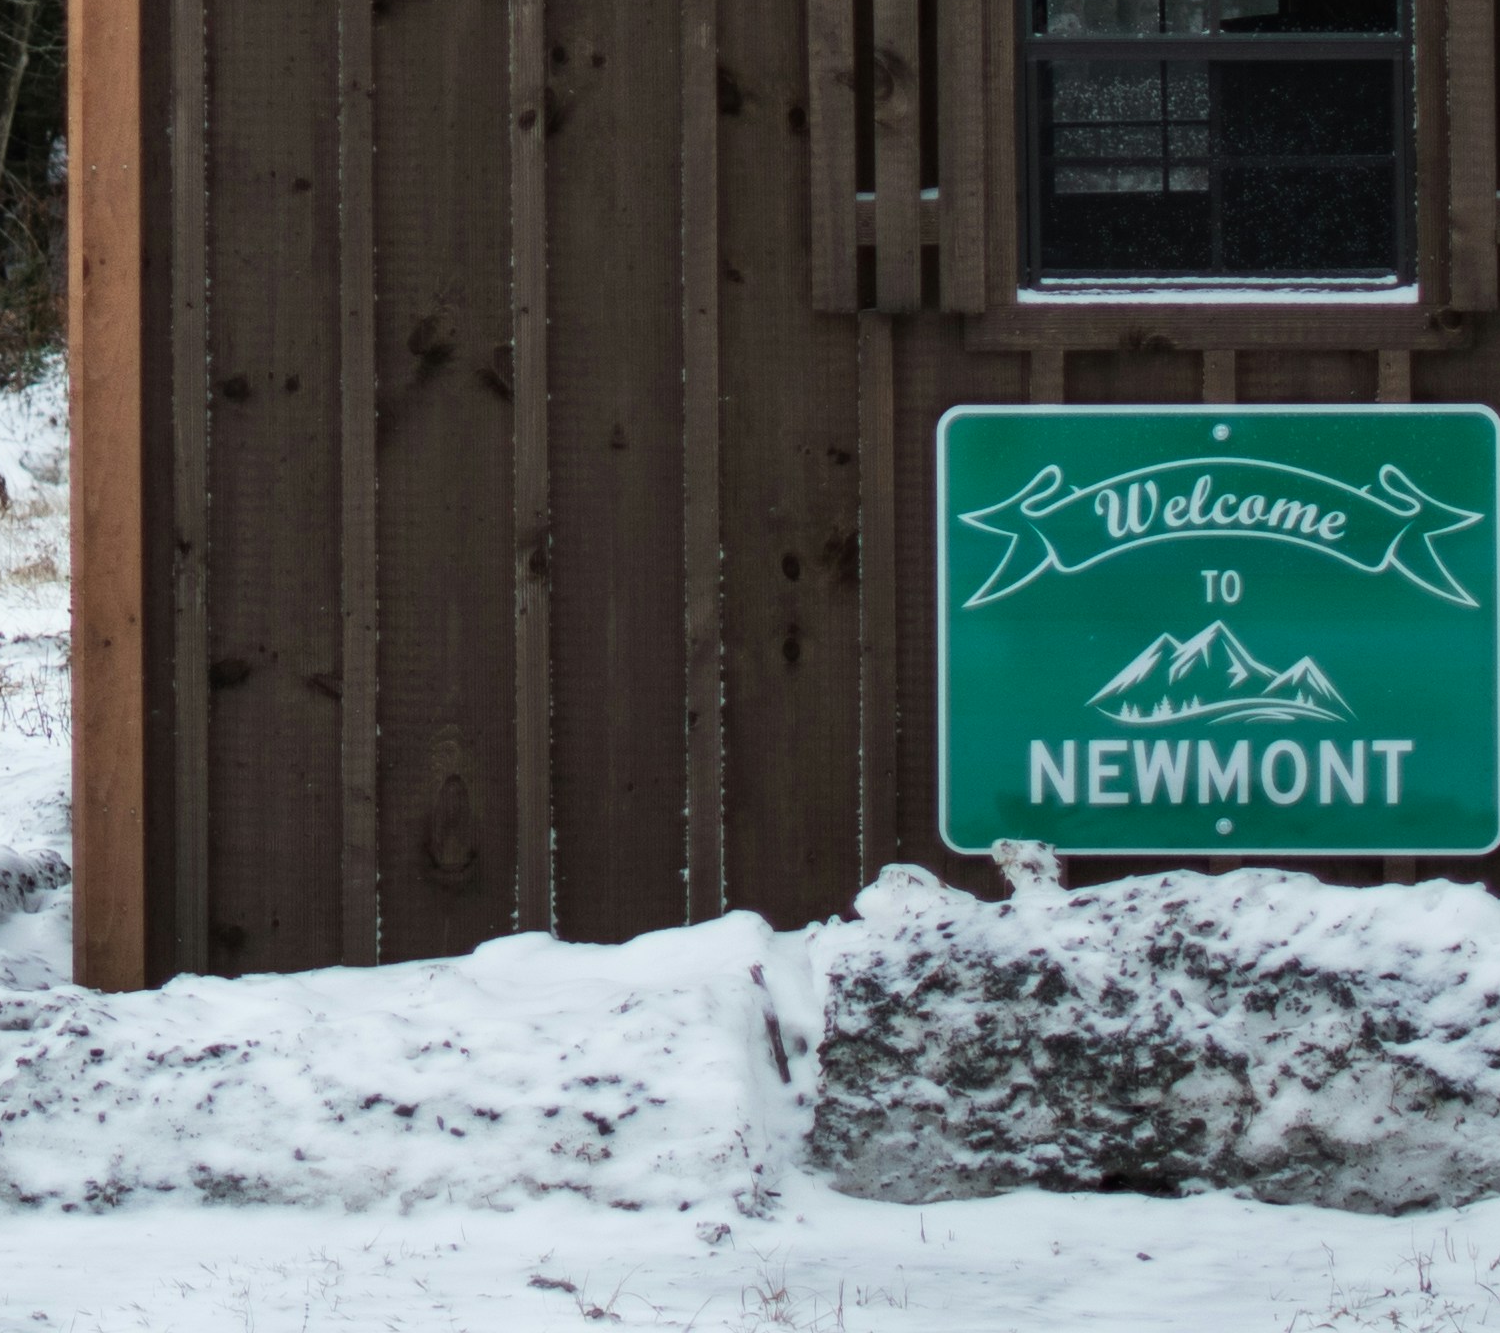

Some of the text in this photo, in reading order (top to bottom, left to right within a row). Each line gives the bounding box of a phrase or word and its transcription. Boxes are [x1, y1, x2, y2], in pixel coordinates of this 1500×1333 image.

[1094, 474, 1348, 540] Welcome
[1201, 569, 1242, 604] TO
[1029, 739, 1414, 806] NEWMONT
